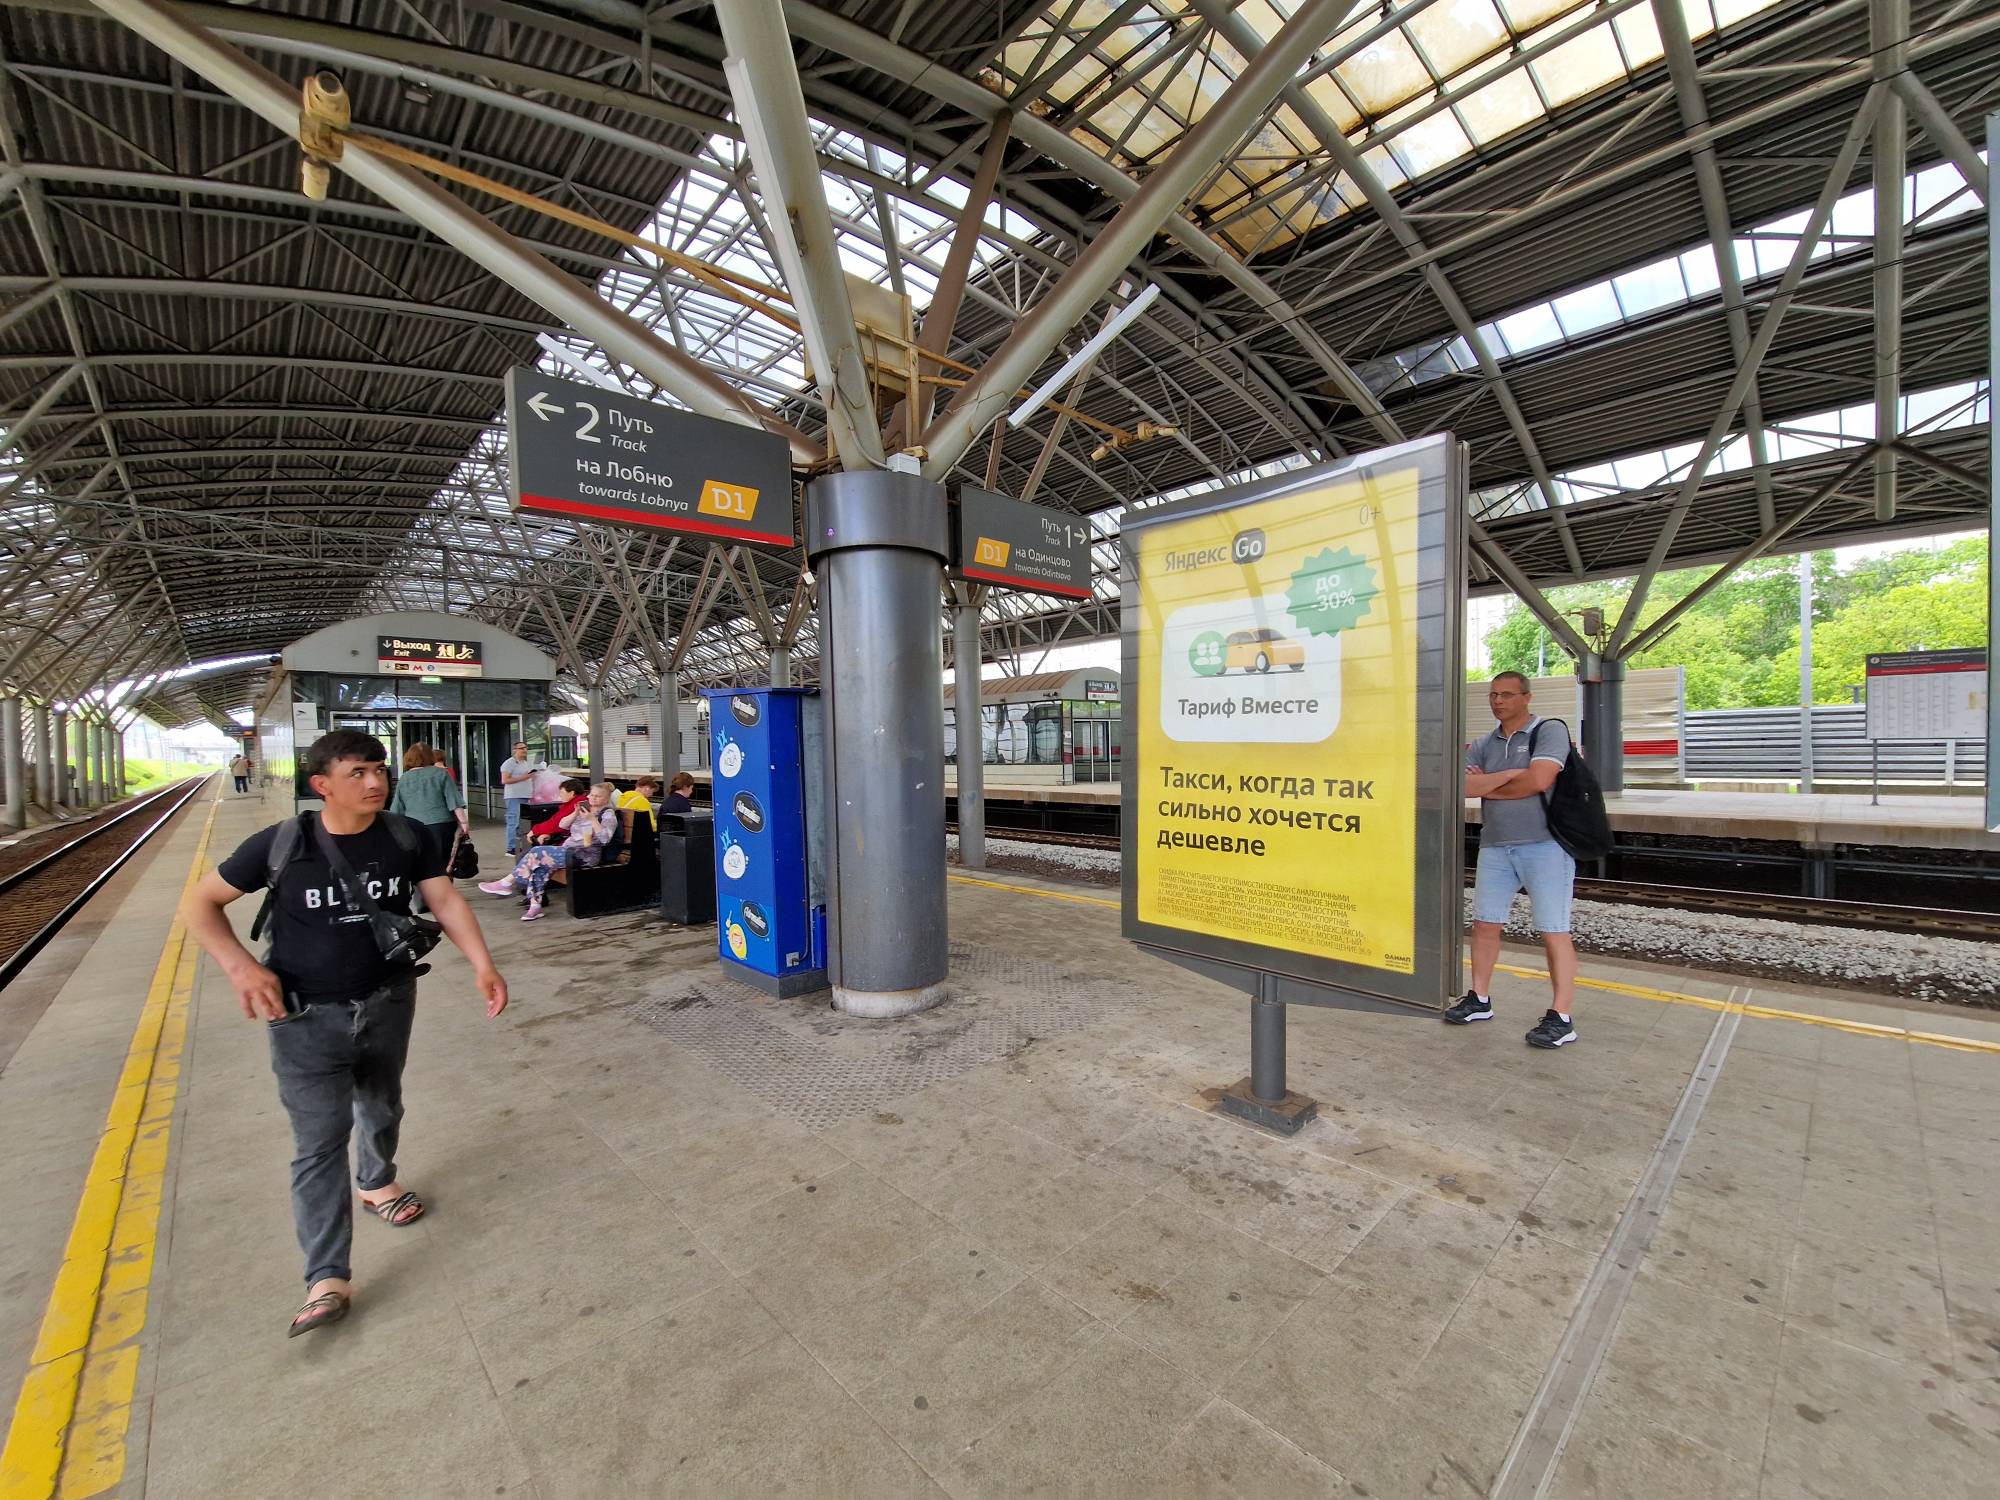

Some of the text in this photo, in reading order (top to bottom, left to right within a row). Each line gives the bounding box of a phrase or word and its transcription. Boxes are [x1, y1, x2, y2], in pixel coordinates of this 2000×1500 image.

[575, 402, 654, 443] 2 Путь
[610, 434, 647, 453] Track
[576, 459, 673, 488] на Лобню
[579, 481, 689, 512] towards Lobnya
[711, 487, 747, 514] D1
[1359, 504, 1381, 526] 0+
[1041, 517, 1072, 549] Путь 1
[1045, 535, 1061, 546] Track
[982, 543, 1003, 563] D1
[1015, 547, 1071, 568] на Одинцово
[1165, 536, 1262, 571] Яндекс Go
[1015, 563, 1041, 576] towards
[1315, 573, 1341, 594] до
[1310, 588, 1357, 613] -30%
[393, 639, 432, 652] Выход
[393, 649, 410, 657] Exit
[1178, 697, 1319, 718] Тариф Вместе
[1160, 766, 1374, 800] Такси, когда так
[1158, 800, 1361, 833] сильно хочется
[1157, 829, 1266, 856] дешевле
[305, 877, 400, 909] BLCK
[1273, 892, 1323, 905] МАКСИМАЛЬНОЕ
[1324, 900, 1356, 911] ЗНАЧЕНИЕ
[1300, 913, 1349, 927] ТРАНСПОРТНЫЕ
[1312, 907, 1347, 918] ДОСТУПНА
